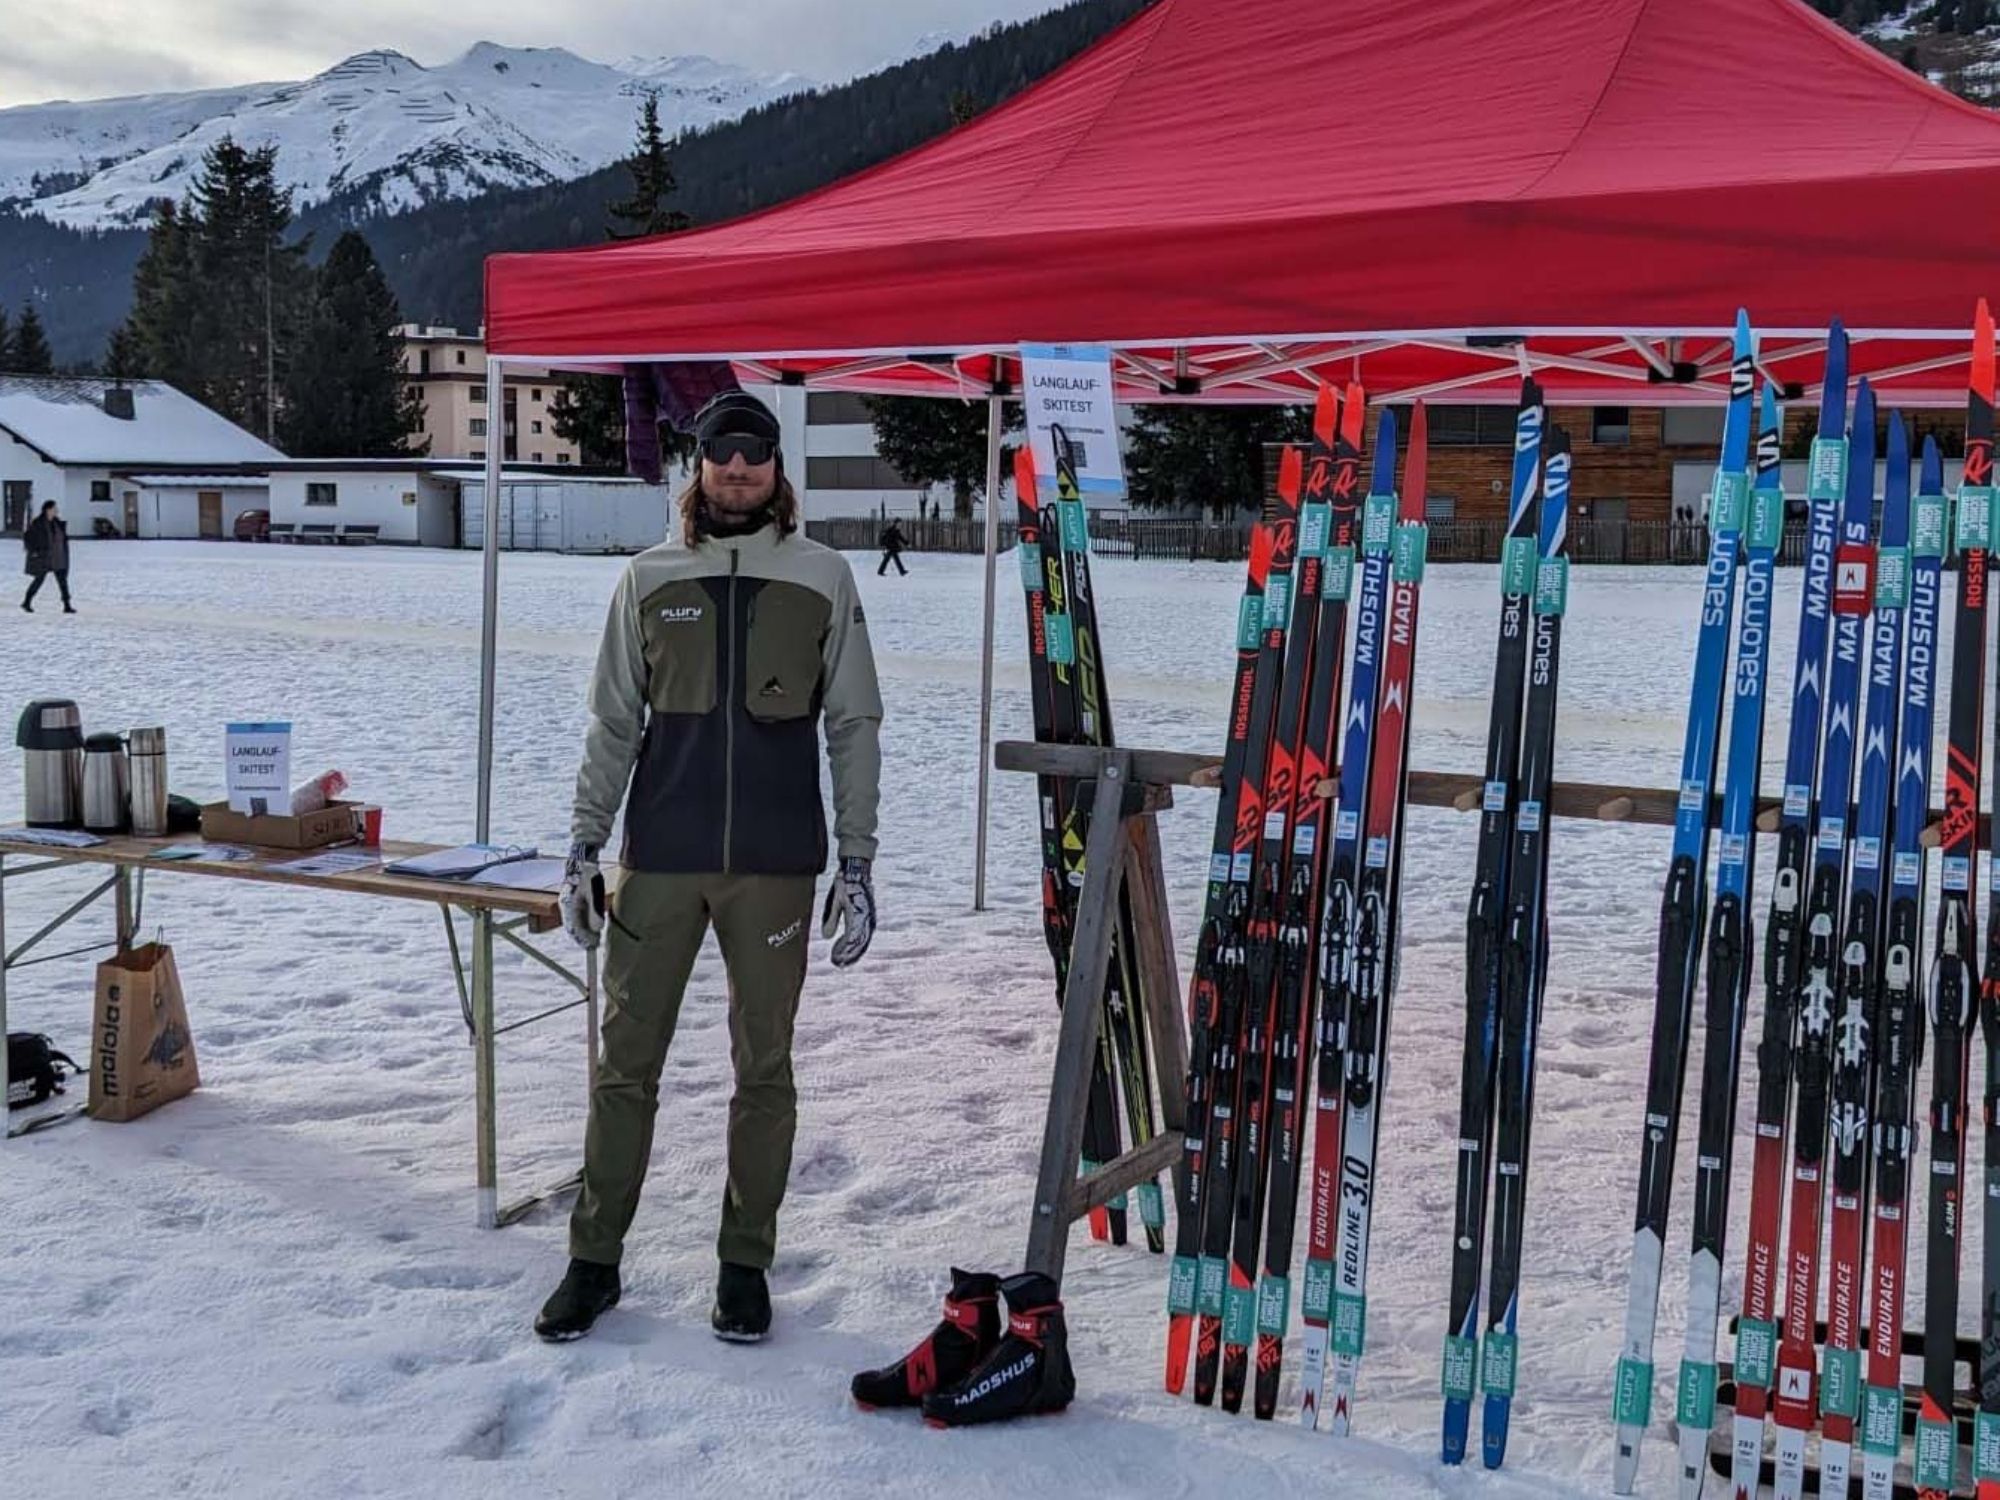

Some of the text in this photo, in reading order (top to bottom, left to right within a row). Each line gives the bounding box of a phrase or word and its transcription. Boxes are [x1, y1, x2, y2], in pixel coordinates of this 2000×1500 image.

[1032, 375, 1101, 391] LANGLAUF-
[1042, 398, 1093, 413] SKITEST
[1032, 591, 1045, 656] ROSSIGNO
[1908, 567, 1936, 707] MADSHUS
[1234, 666, 1255, 740] ROSSIGNOL
[232, 746, 281, 758] LANGLAUF-
[238, 764, 276, 774] SKITEST
[99, 1003, 120, 1097] maloja
[1315, 1167, 1331, 1249] ENDURACE
[1343, 1155, 1370, 1287] REDLINE 3.0
[1751, 1242, 1769, 1320] NDURACE
[1792, 1252, 1810, 1341] ENDURACE
[1834, 1261, 1852, 1350] ENDURACE
[1877, 1265, 1895, 1358] ENDURACE
[954, 1352, 1036, 1408] MADSHUS
